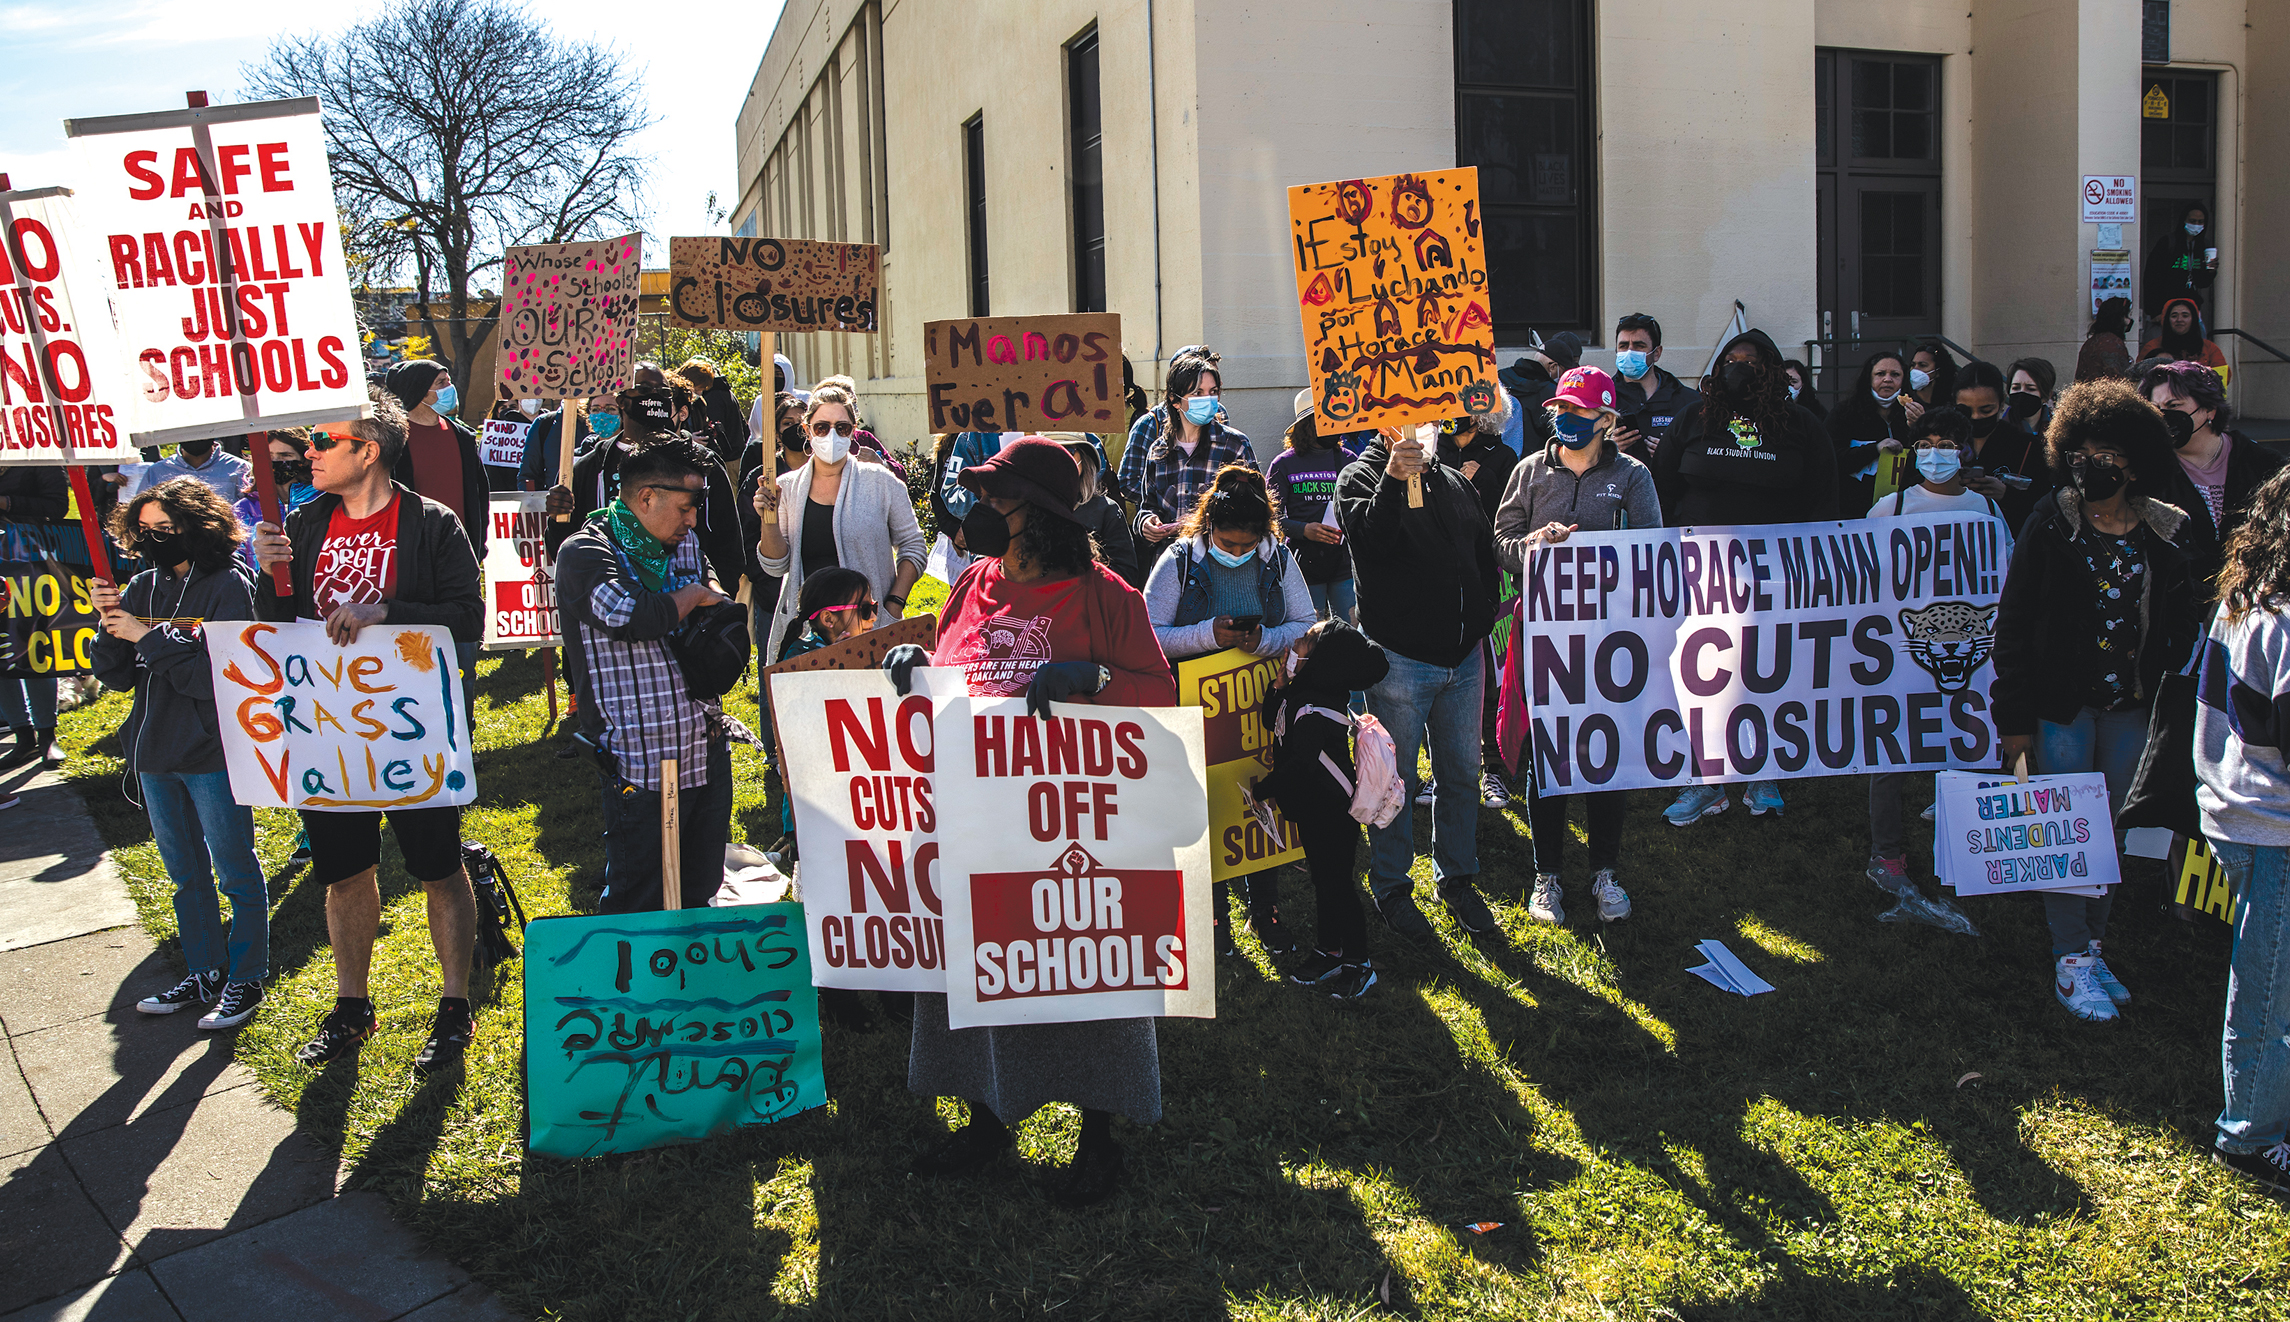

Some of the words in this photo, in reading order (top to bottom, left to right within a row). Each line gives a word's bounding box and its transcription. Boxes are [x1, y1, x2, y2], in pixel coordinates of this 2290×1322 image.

[124, 142, 294, 201] SAFE
[1539, 173, 1565, 185] LIVES
[2106, 189, 2132, 197] SMOKING
[2113, 179, 2125, 188] NO
[188, 201, 244, 220] AND
[2105, 197, 2133, 205] ALLOWED
[107, 222, 324, 290] RACIALLY
[514, 251, 583, 273] Whose
[720, 236, 786, 272] NO
[565, 263, 641, 298] Schools?
[1345, 258, 1487, 304] Luchando
[0, 285, 71, 334] UTS.
[181, 282, 290, 343] JUST
[511, 307, 595, 348] OUR
[1319, 310, 1364, 341] por
[543, 336, 634, 389] Schools!
[1338, 328, 1442, 362] Horace
[0, 339, 91, 403] NO
[138, 336, 349, 403] SCHOOLS
[0, 404, 118, 450] LOSURES
[484, 435, 526, 448] SCHOOLS
[1706, 446, 1725, 457] BLACK
[1725, 448, 1752, 459] STUDENT
[1753, 451, 1777, 461] UNION
[1292, 481, 1319, 494] BLACK
[1528, 544, 1619, 622] KEEP
[1631, 538, 1773, 620] HORACE
[1777, 531, 1881, 611] MANN
[1890, 520, 2000, 602] OPEN!!
[8, 574, 60, 618] NO
[222, 622, 399, 696] Save
[971, 671, 1014, 682] OAKLAND
[979, 661, 999, 671] ARE
[1000, 660, 1018, 670] THE
[1531, 630, 1649, 707] NO
[1680, 614, 1894, 697] CUTS
[236, 694, 426, 743] GRASS
[1239, 710, 1274, 752] UR
[1531, 712, 1621, 789] NO
[1644, 689, 2002, 782] CLOSURES
[974, 715, 1148, 780] HANDS
[849, 775, 936, 834] CUTS
[1028, 780, 1119, 843] OFF
[1975, 784, 2072, 821] MATTER
[1966, 817, 2091, 855] STUDENTS
[1986, 850, 2089, 885] PARKER
[1031, 875, 1125, 934] OUR
[821, 914, 946, 971] CLOSU
[976, 933, 1186, 996] SCHOOLS
